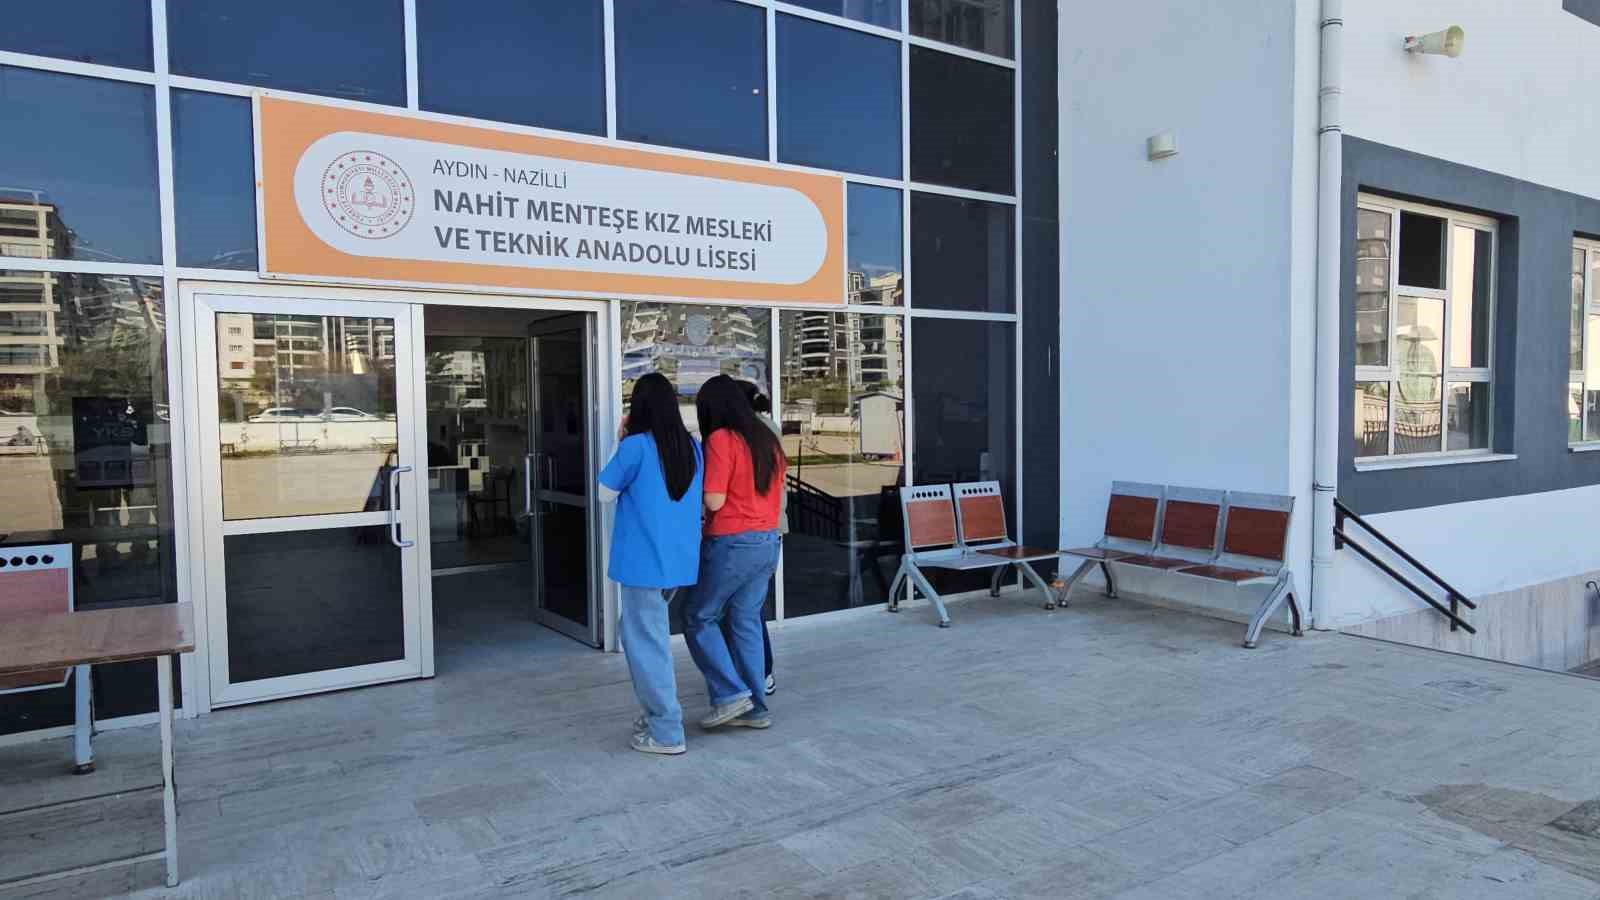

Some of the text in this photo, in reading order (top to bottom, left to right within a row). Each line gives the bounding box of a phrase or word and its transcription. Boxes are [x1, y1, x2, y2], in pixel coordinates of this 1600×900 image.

[432, 159, 488, 180] AYDIN
[504, 167, 567, 189] NAZİLLİ
[433, 188, 520, 219] NAHİT
[527, 199, 639, 234] MENTEŞE
[645, 211, 681, 234] KIZ
[686, 215, 772, 242] MESLEKİ
[433, 225, 756, 272] VE TEKNİK ANADOLU LİSESİ
